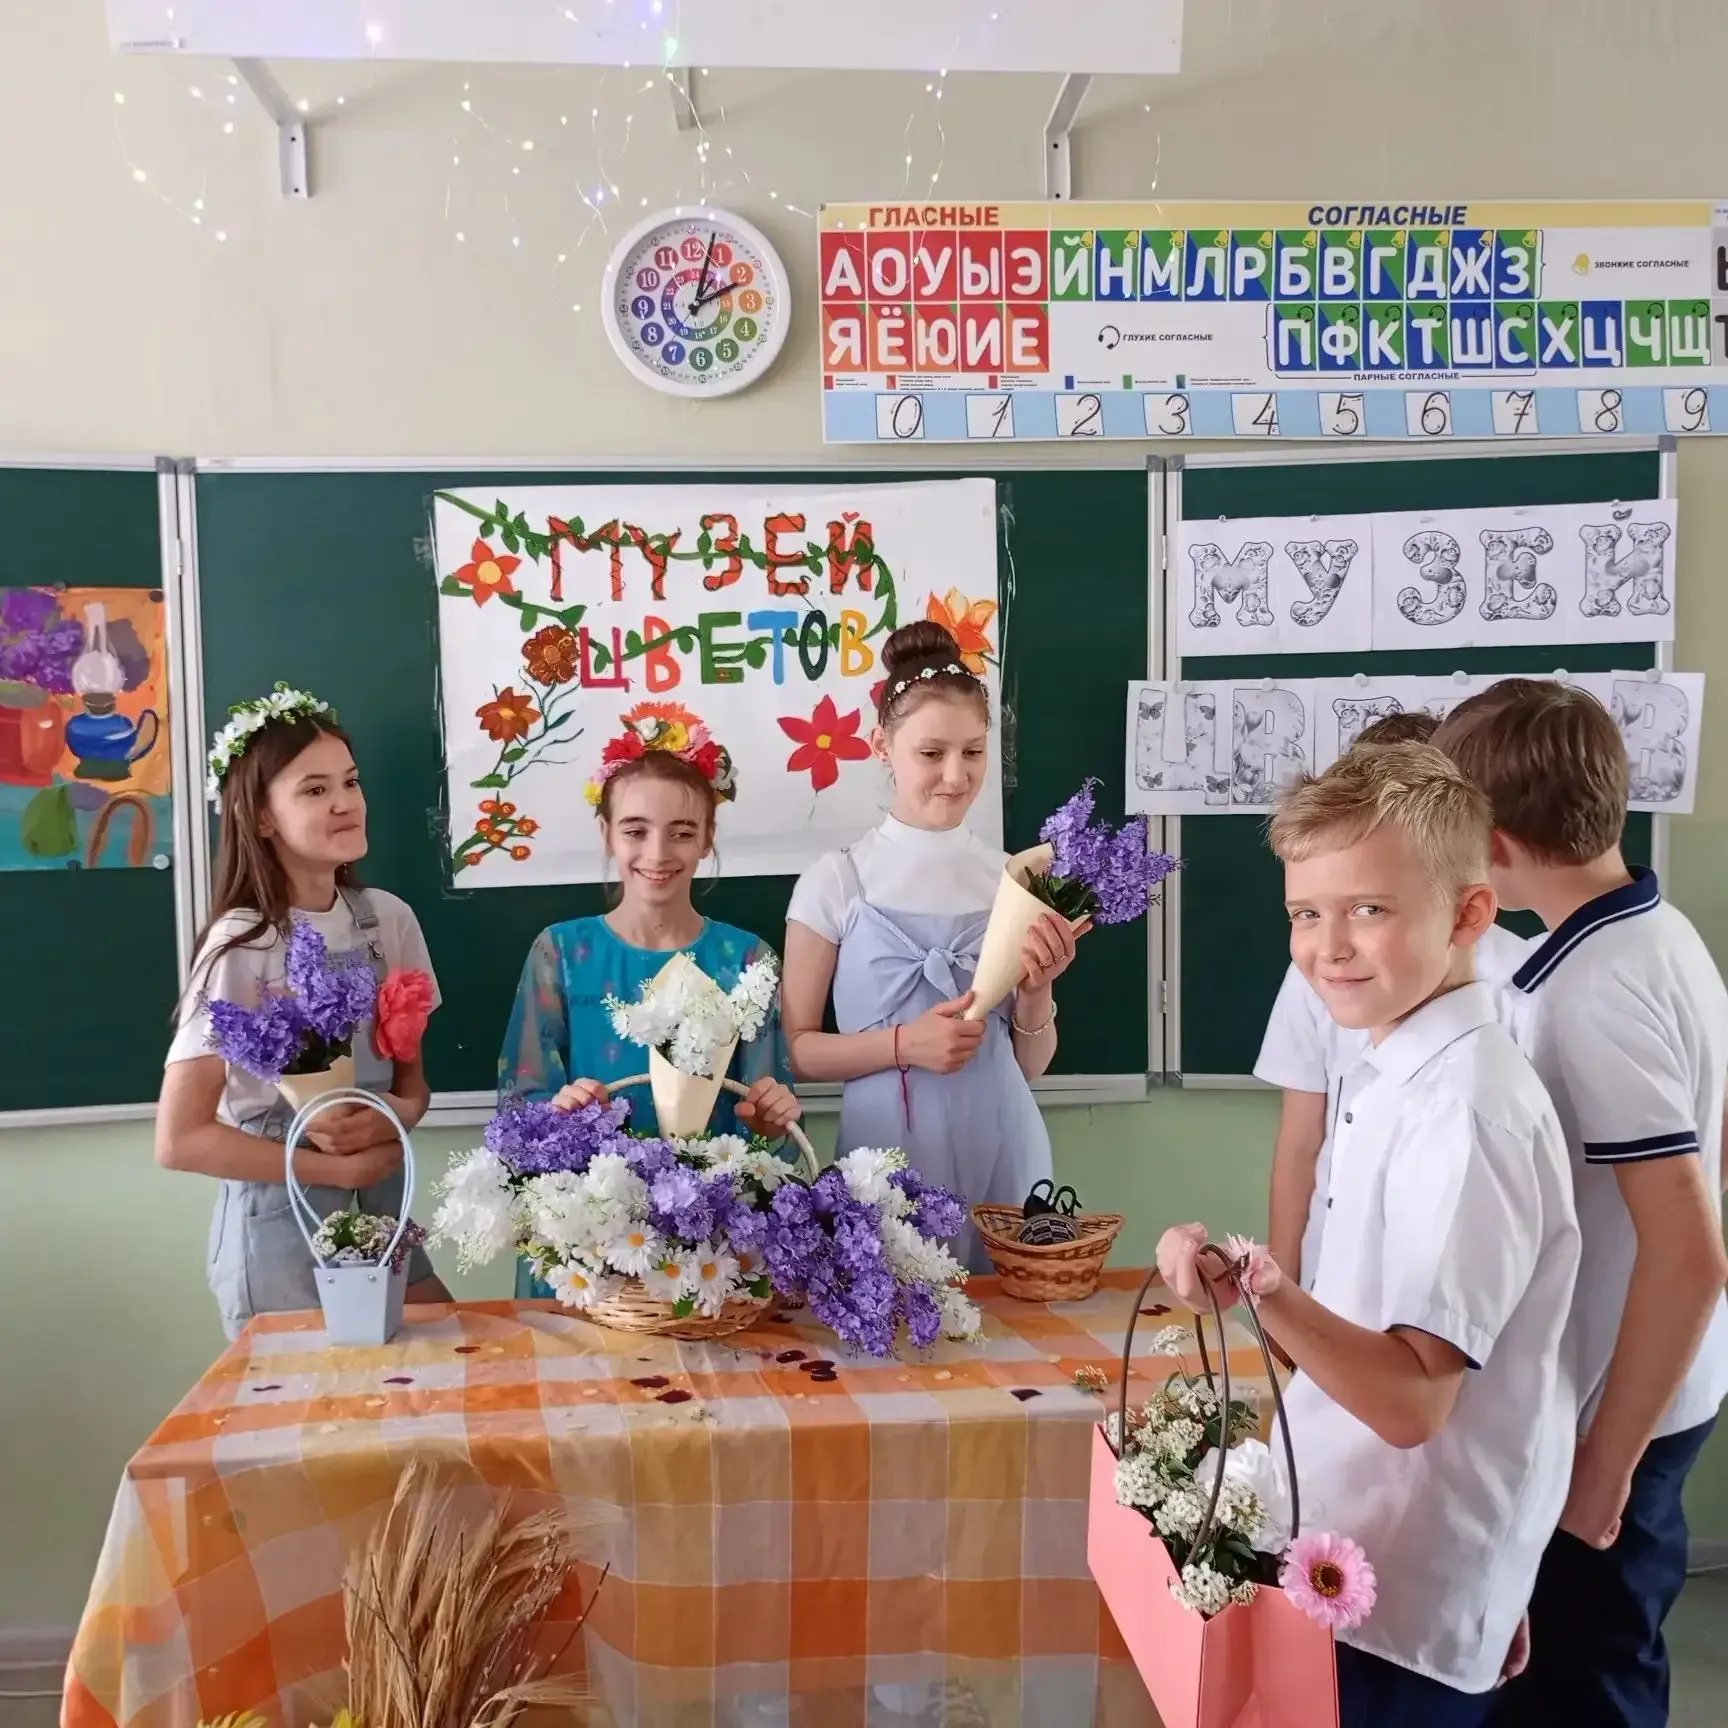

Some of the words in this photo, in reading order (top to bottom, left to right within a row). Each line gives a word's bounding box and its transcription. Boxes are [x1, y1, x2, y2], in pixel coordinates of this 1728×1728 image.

[869, 206, 1000, 227] ГЛАСНЫЕ
[1307, 205, 1467, 226] СОГЛАСНЫЕ
[659, 250, 675, 266] 11
[684, 242, 702, 259] 12
[717, 248, 726, 264] 1
[825, 247, 863, 297] А
[872, 247, 907, 297] О
[915, 247, 952, 297] У
[961, 247, 999, 297] Ы
[1010, 247, 1041, 297] Э
[1053, 236, 1088, 297] Й
[1099, 247, 1132, 297] Н
[1143, 247, 1181, 297] М
[1187, 247, 1227, 297] Л
[1234, 247, 1267, 297] Р
[1279, 247, 1311, 297] Б
[1324, 247, 1355, 297] В
[1370, 247, 1398, 294] Г
[1408, 247, 1447, 299] Д
[1451, 247, 1491, 294] Ж
[1499, 247, 1529, 294] З
[1594, 260, 1633, 268] ЗВОНКИЕ
[1635, 259, 1690, 268] СОГЛАСНЫЕ
[640, 271, 657, 288] 10
[736, 267, 747, 283] 2
[638, 299, 649, 315] 9
[745, 294, 756, 309] 3
[647, 326, 657, 342] 8
[740, 321, 751, 337] 4
[828, 319, 862, 366] Я
[877, 307, 907, 366] Ё
[917, 319, 956, 366] Ю
[966, 319, 1000, 366] И
[1012, 319, 1039, 366] Е
[1122, 333, 1157, 342] ГЛУХИЕ
[1159, 333, 1214, 342] СОГЛАСНЫЕ
[1278, 319, 1312, 366] П
[1321, 319, 1359, 366] Ф
[1368, 319, 1401, 366] К
[1411, 319, 1444, 366] Т
[1452, 319, 1491, 366] Ш
[1499, 319, 1529, 363] С
[1541, 317, 1576, 363] Х
[1584, 316, 1621, 367] Ц
[1630, 315, 1662, 362] Ч
[1671, 315, 1710, 365] Щ
[668, 345, 678, 361] 7
[695, 351, 706, 367] 6
[722, 343, 732, 359] 5
[1353, 373, 1397, 381] ПАРНЫЕ
[1398, 372, 1460, 381] СОГЛАСНЫЕ
[892, 394, 924, 438] 0
[991, 393, 1013, 437] 1
[1071, 393, 1102, 436] 2
[1157, 393, 1189, 436] 3
[1252, 393, 1279, 436] 4
[1332, 391, 1365, 435] 5
[1421, 392, 1450, 435] 6
[1506, 391, 1535, 433] 7
[1594, 391, 1623, 432] 8
[1681, 388, 1708, 431] 9
[549, 512, 873, 602] МУЗЕЙ
[579, 609, 874, 694] ЦВЕТОВ
